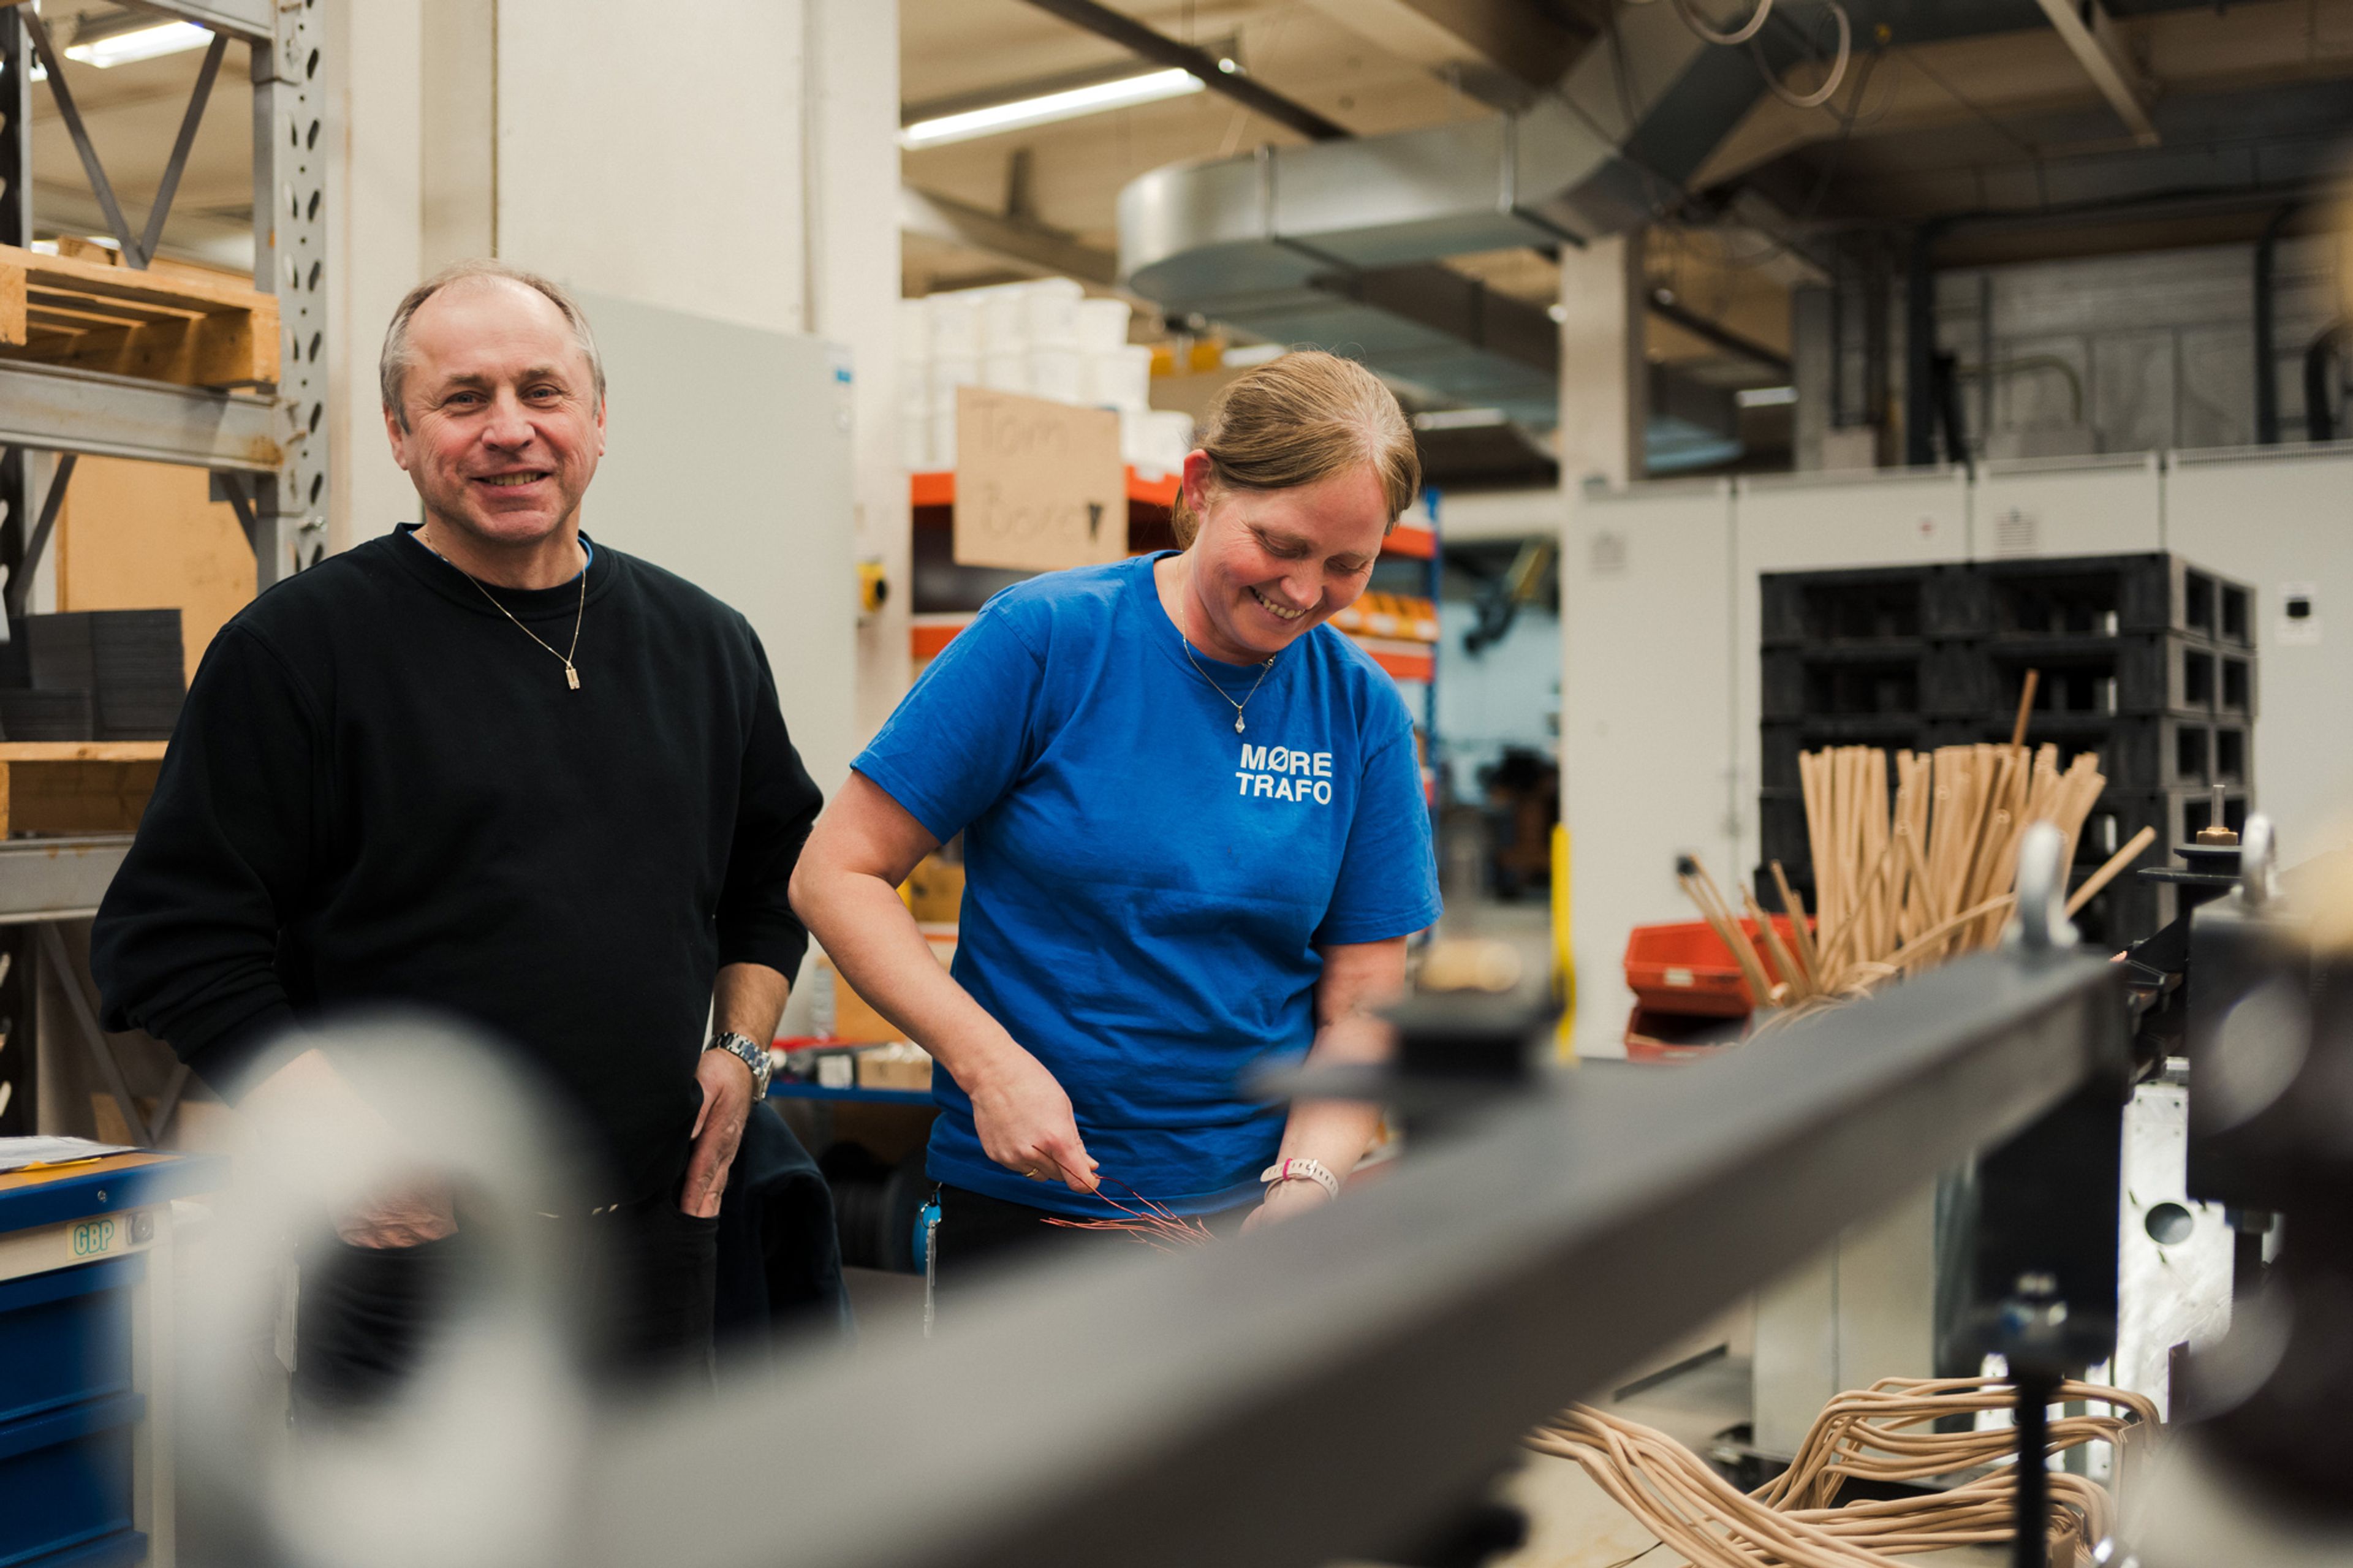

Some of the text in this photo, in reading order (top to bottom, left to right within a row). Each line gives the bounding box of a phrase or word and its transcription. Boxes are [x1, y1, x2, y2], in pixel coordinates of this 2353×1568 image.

[968, 398, 1069, 457] Tom
[1240, 743, 1333, 778] MØRE
[1235, 771, 1332, 805] TRAFO
[74, 1219, 115, 1256] GBP
